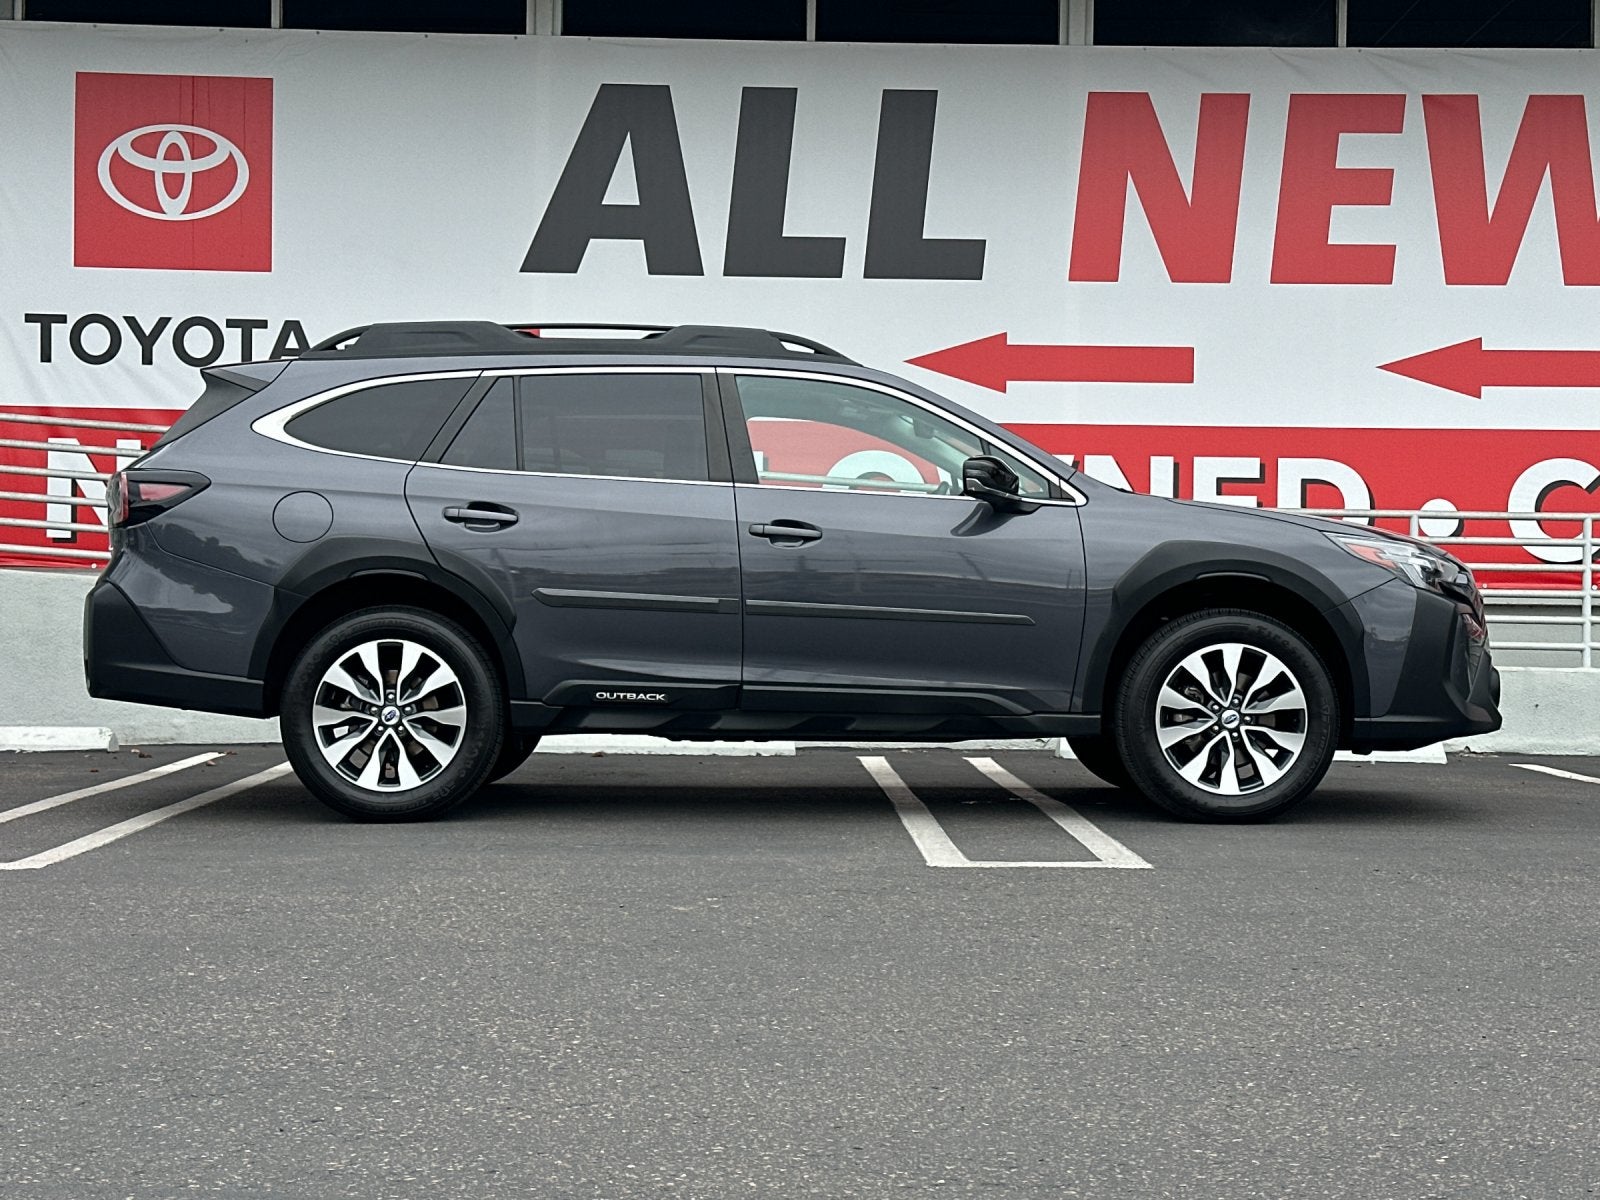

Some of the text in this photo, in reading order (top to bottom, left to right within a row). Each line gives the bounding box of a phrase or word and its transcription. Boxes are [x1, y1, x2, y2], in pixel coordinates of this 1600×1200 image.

[519, 83, 1600, 286] ALL NEW
[24, 313, 311, 368] TOYOTA
[595, 691, 666, 700] OUTBACK
